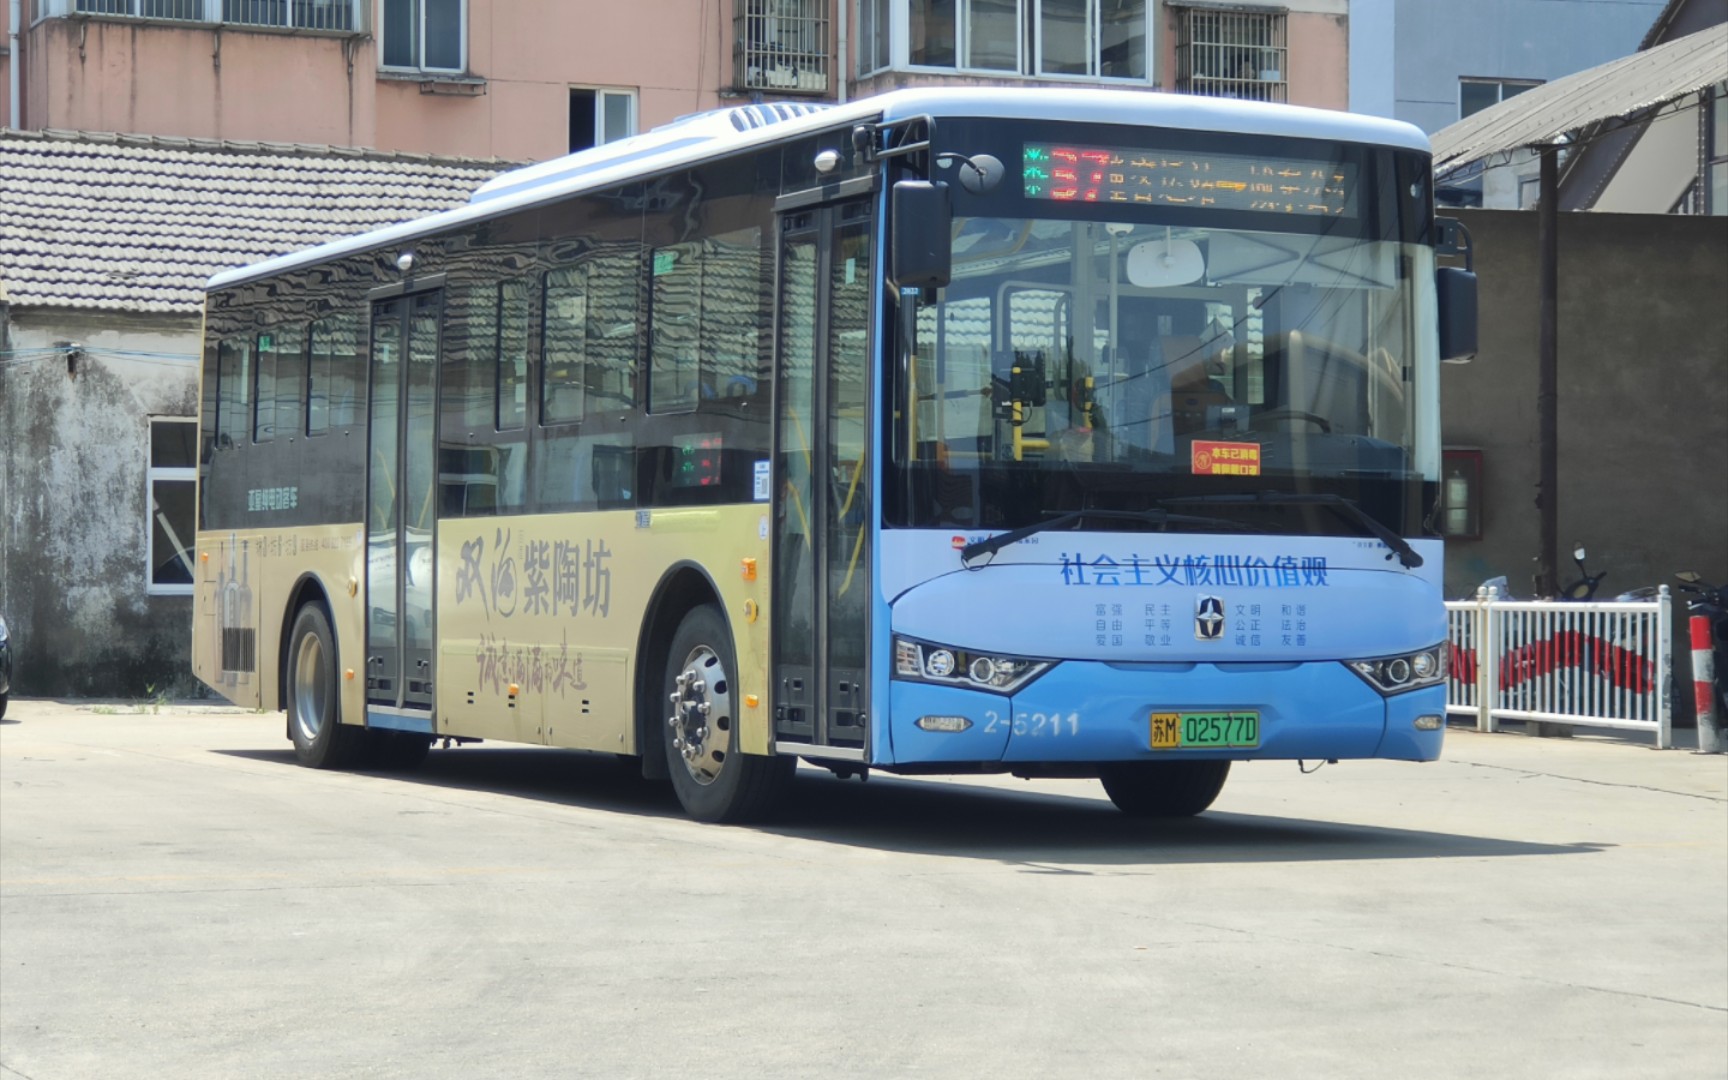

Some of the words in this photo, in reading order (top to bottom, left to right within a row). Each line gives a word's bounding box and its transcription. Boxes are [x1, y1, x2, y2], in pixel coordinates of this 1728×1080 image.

[1058, 552, 1331, 587] 社会主义核心价值观
[1145, 604, 1171, 616] 民主
[1235, 604, 1260, 616] 文明
[1096, 619, 1122, 631] 自由
[1235, 619, 1260, 631] 公正
[983, 710, 1079, 736] 2-5211
